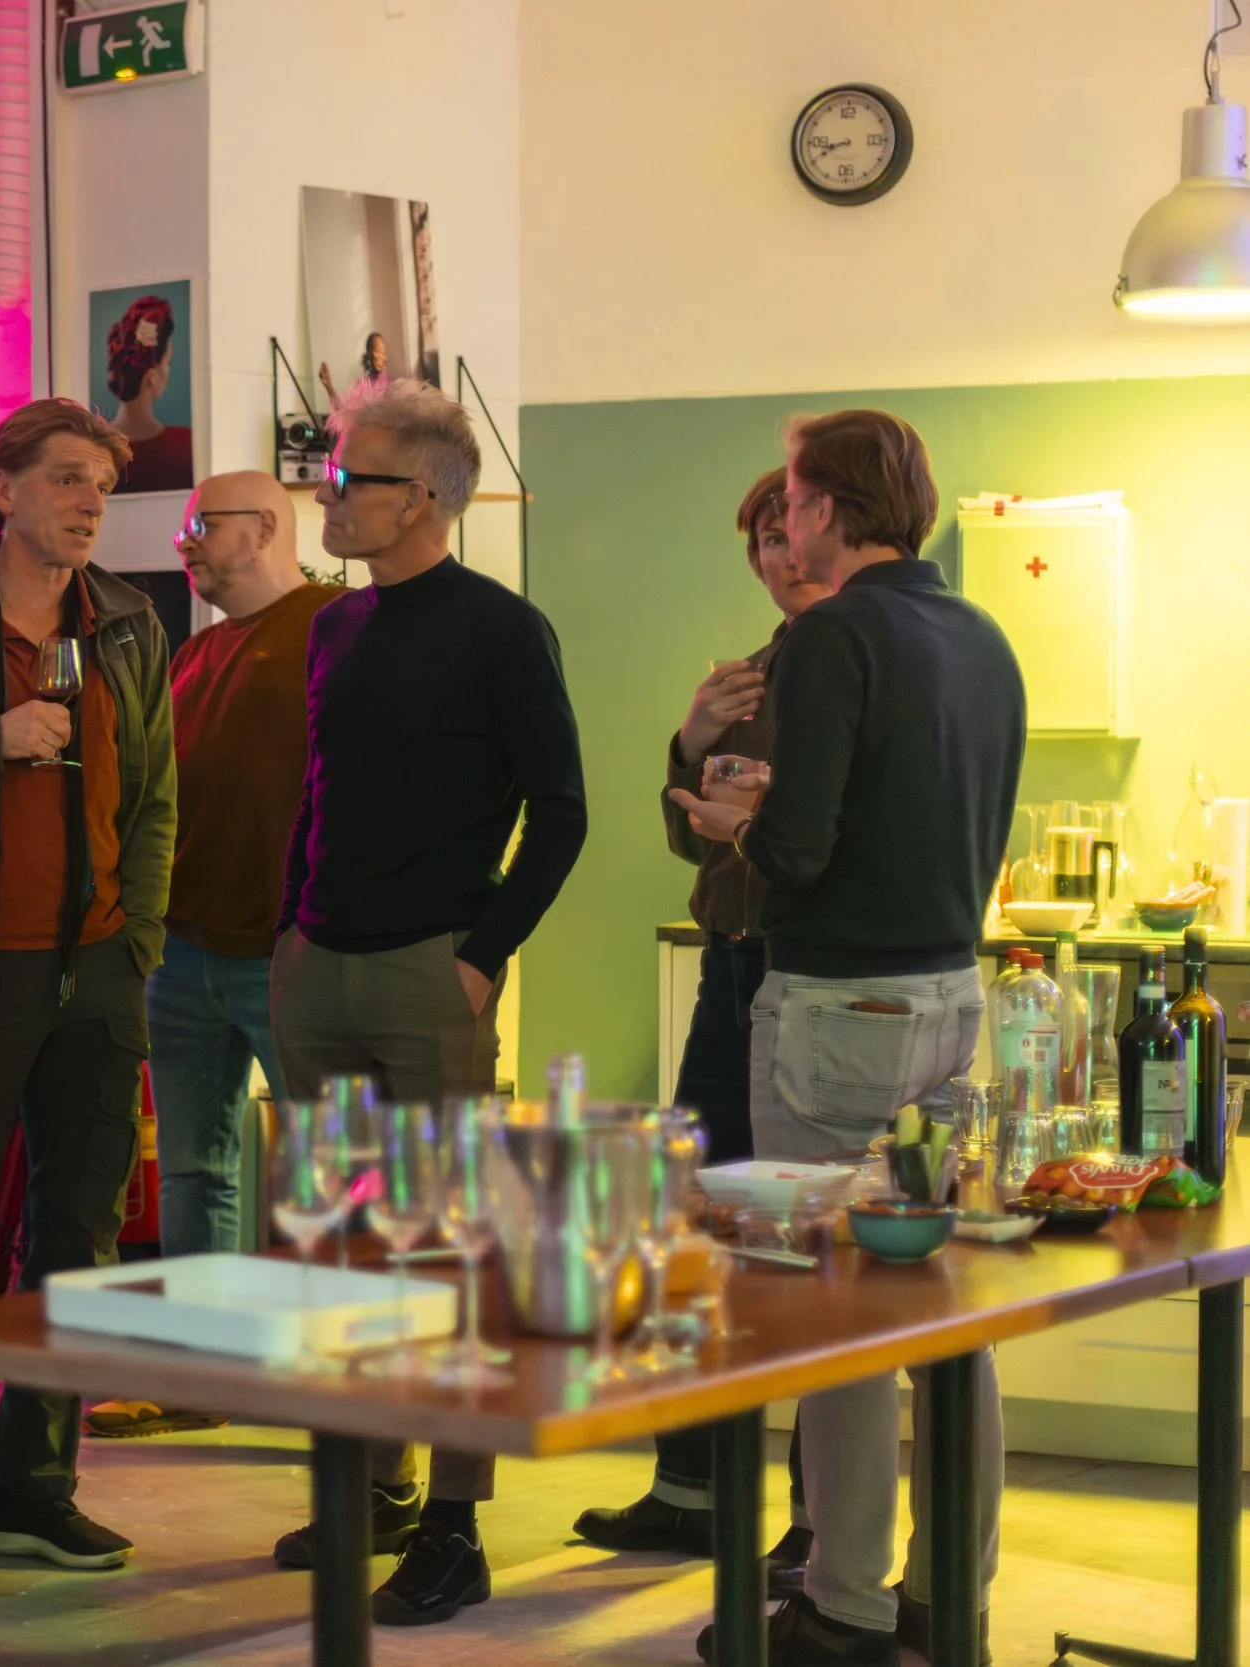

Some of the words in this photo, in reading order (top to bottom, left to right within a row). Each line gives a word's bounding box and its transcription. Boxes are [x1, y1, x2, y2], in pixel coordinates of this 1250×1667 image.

[841, 107, 856, 118] 12
[813, 136, 828, 148] 09
[867, 134, 883, 145] 03
[838, 165, 854, 176] 06
